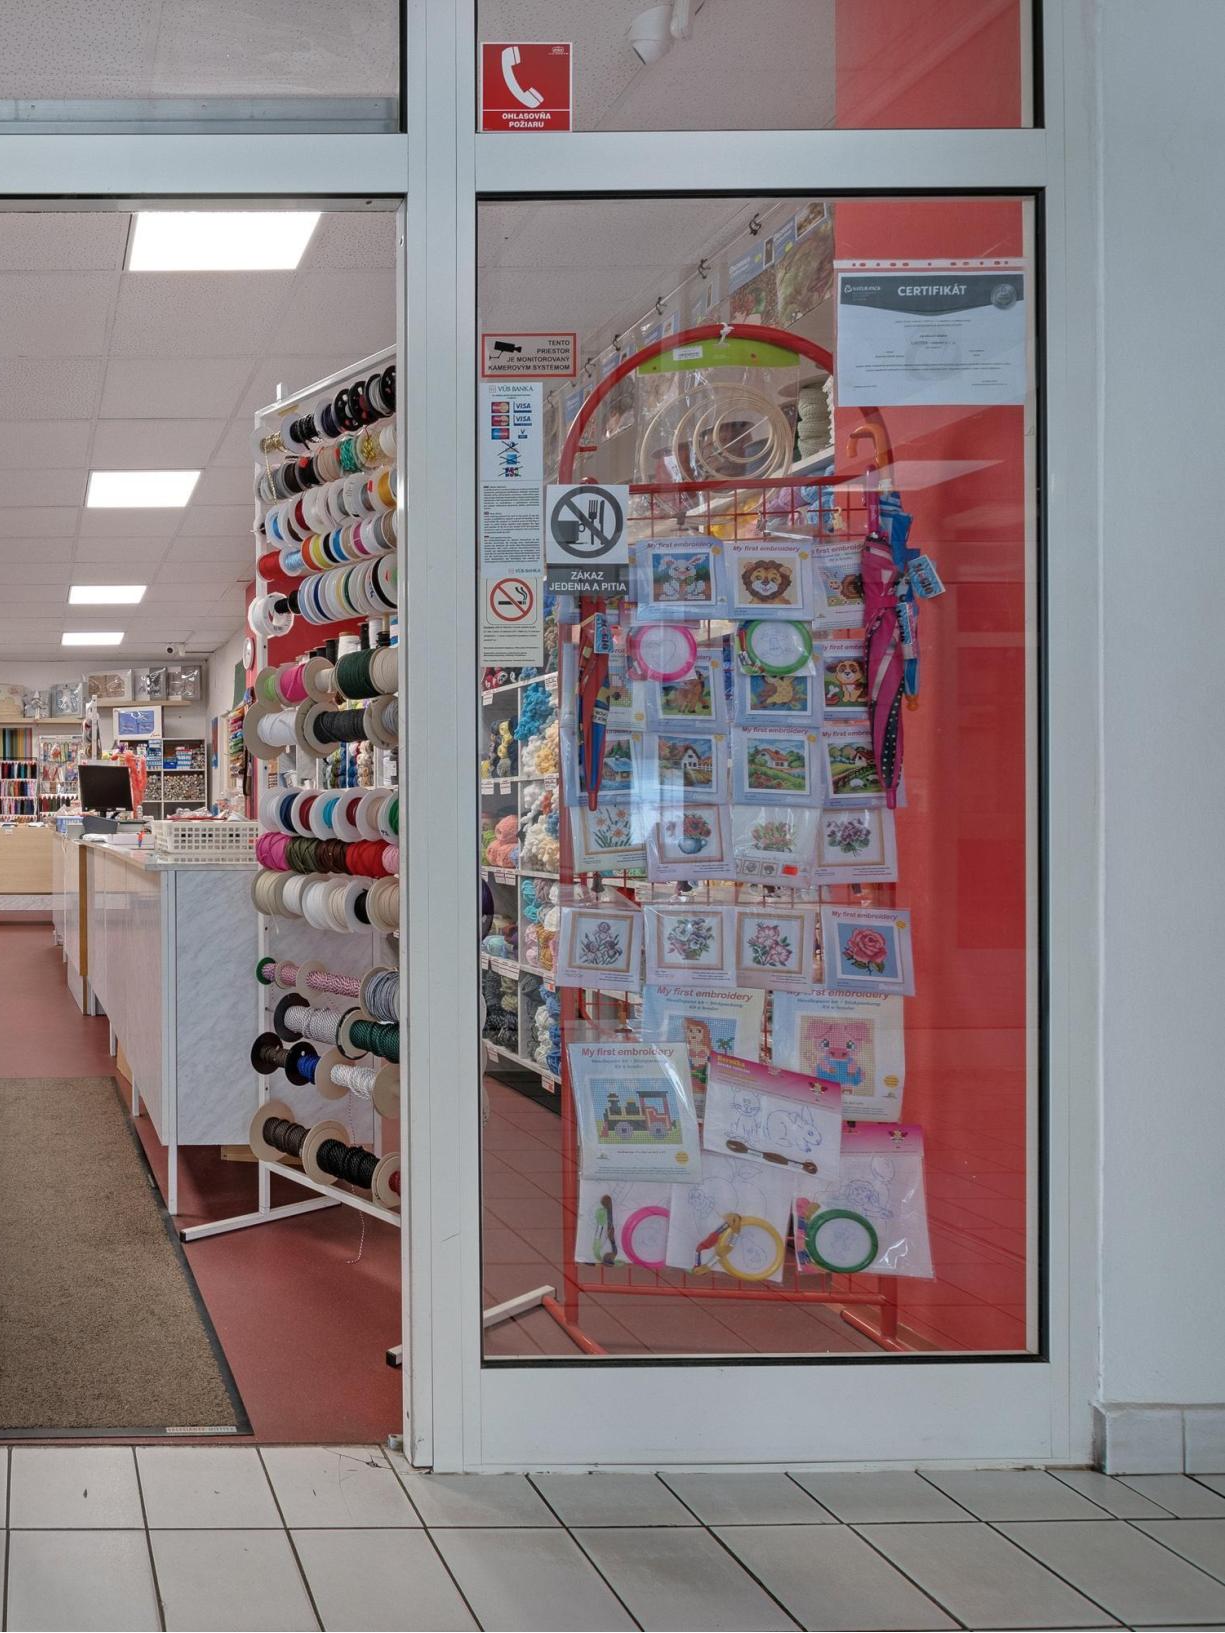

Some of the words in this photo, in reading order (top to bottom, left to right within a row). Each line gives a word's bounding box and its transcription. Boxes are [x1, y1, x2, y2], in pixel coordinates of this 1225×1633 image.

[502, 112, 551, 120] OHLASOVŇA
[509, 120, 545, 128] POŽIARU
[897, 284, 967, 297] CERTIFIKÁT
[571, 569, 604, 580] ZÁKAZ
[550, 583, 590, 591] JEDENIA
[592, 583, 600, 591] A
[601, 583, 627, 591] PITIA
[657, 985, 672, 998] My
[674, 986, 694, 997] first
[695, 989, 753, 1003] embroidery
[581, 1047, 595, 1057] My
[597, 1047, 616, 1056] first
